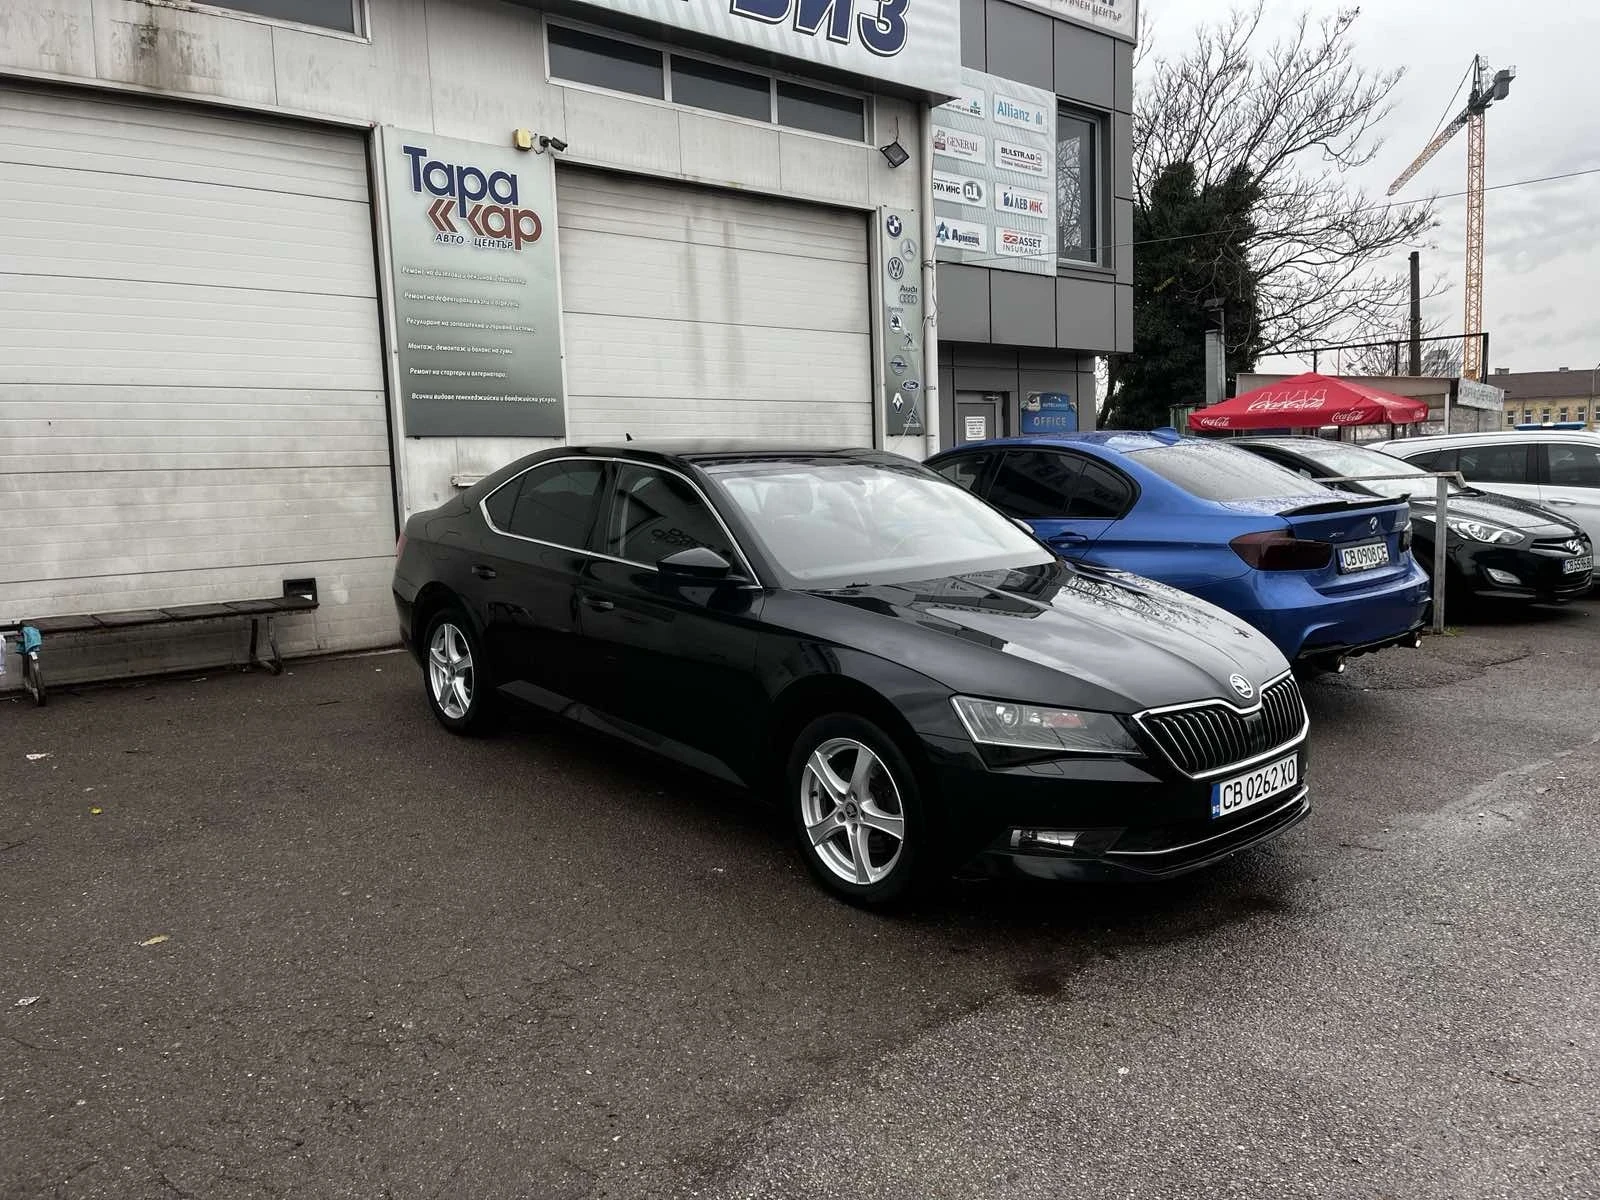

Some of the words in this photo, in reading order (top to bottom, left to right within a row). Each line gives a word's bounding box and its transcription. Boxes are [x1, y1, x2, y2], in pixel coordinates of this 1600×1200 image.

[1092, 4, 1122, 21] ЦЕНТЪР
[997, 101, 1030, 122] Allianz
[946, 136, 978, 153] GENERALI
[1000, 147, 1035, 161] BULSTRAD
[945, 183, 961, 195] ИНС
[1028, 199, 1043, 213] ИНС
[435, 233, 465, 244] АВТО
[474, 237, 514, 249] ЦЕНТЪР
[1018, 236, 1042, 248] ASSET
[1002, 244, 1042, 255] INSURANCE
[899, 284, 918, 293] Audi
[435, 344, 466, 352] демонтаж
[409, 367, 432, 375] Ремонт
[1033, 416, 1067, 426] OFFICE
[1357, 546, 1378, 564] 0908
[1223, 780, 1243, 810] CB
[1246, 766, 1279, 801] 0262
[1280, 759, 1296, 788] XO
